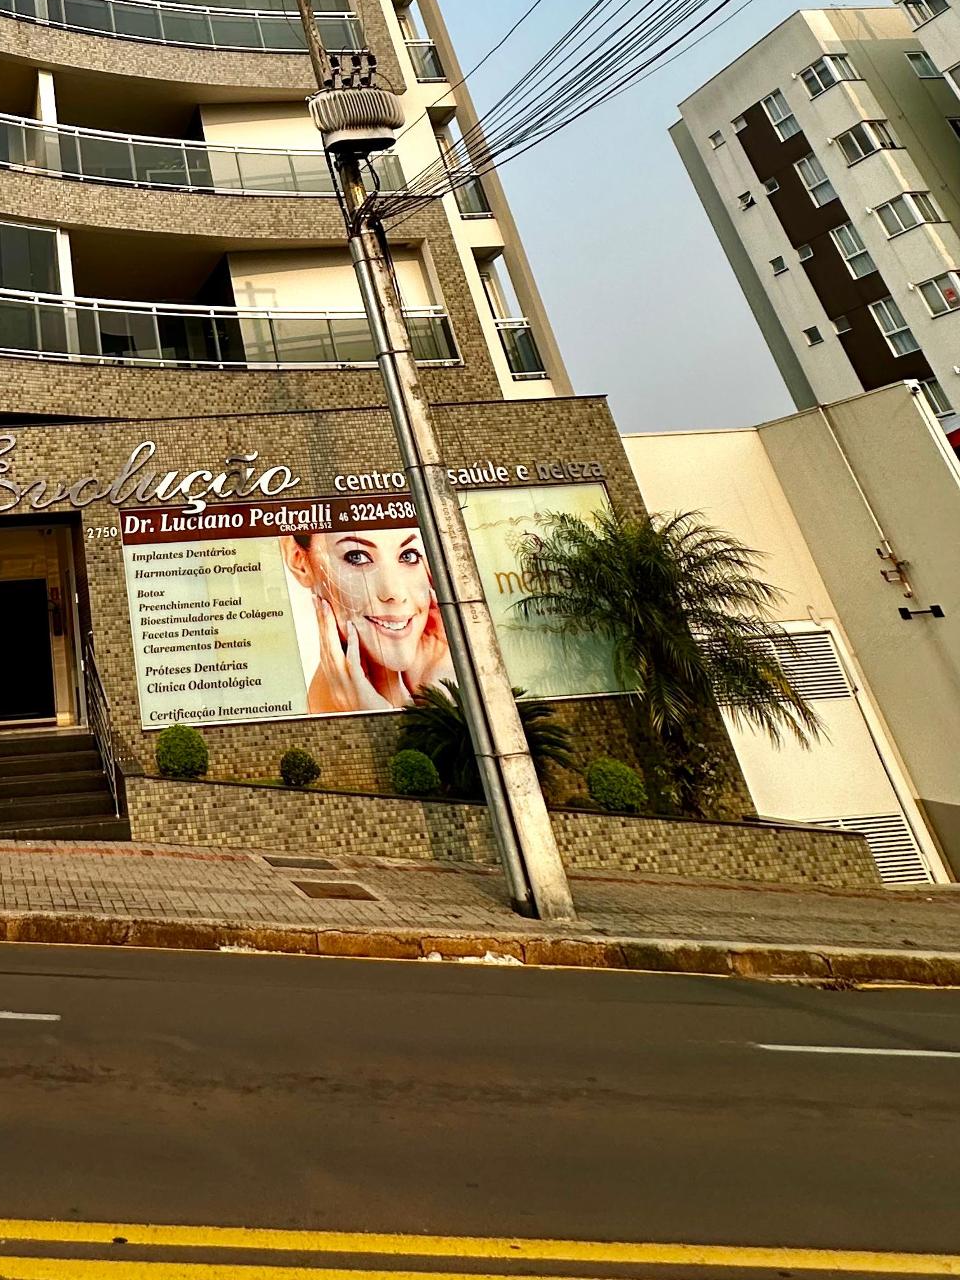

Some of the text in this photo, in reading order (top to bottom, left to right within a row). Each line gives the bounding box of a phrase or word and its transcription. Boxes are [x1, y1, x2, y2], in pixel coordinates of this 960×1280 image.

[334, 459, 605, 492] centro saúde e beleza
[124, 516, 155, 535] Dr.
[160, 512, 244, 532] Luciano
[249, 503, 332, 527] Pedralli
[339, 512, 349, 522] 46
[87, 526, 118, 539] 2750
[280, 523, 309, 532] CRO-PR
[132, 547, 237, 563] Implantes Dentários
[135, 562, 261, 579] Harmonização Orofacial
[137, 589, 165, 599] Botox
[138, 597, 242, 612] Preenchimento Facial
[140, 609, 284, 626] Bioestimuladores de Colágeno
[142, 626, 219, 640] Facetas Dentais
[143, 638, 252, 654] Clareamentos Dentais
[145, 660, 248, 676] Próteses Dentárias
[147, 676, 262, 693] Clínica Odontológica
[150, 701, 292, 722] Certificação Internacional
